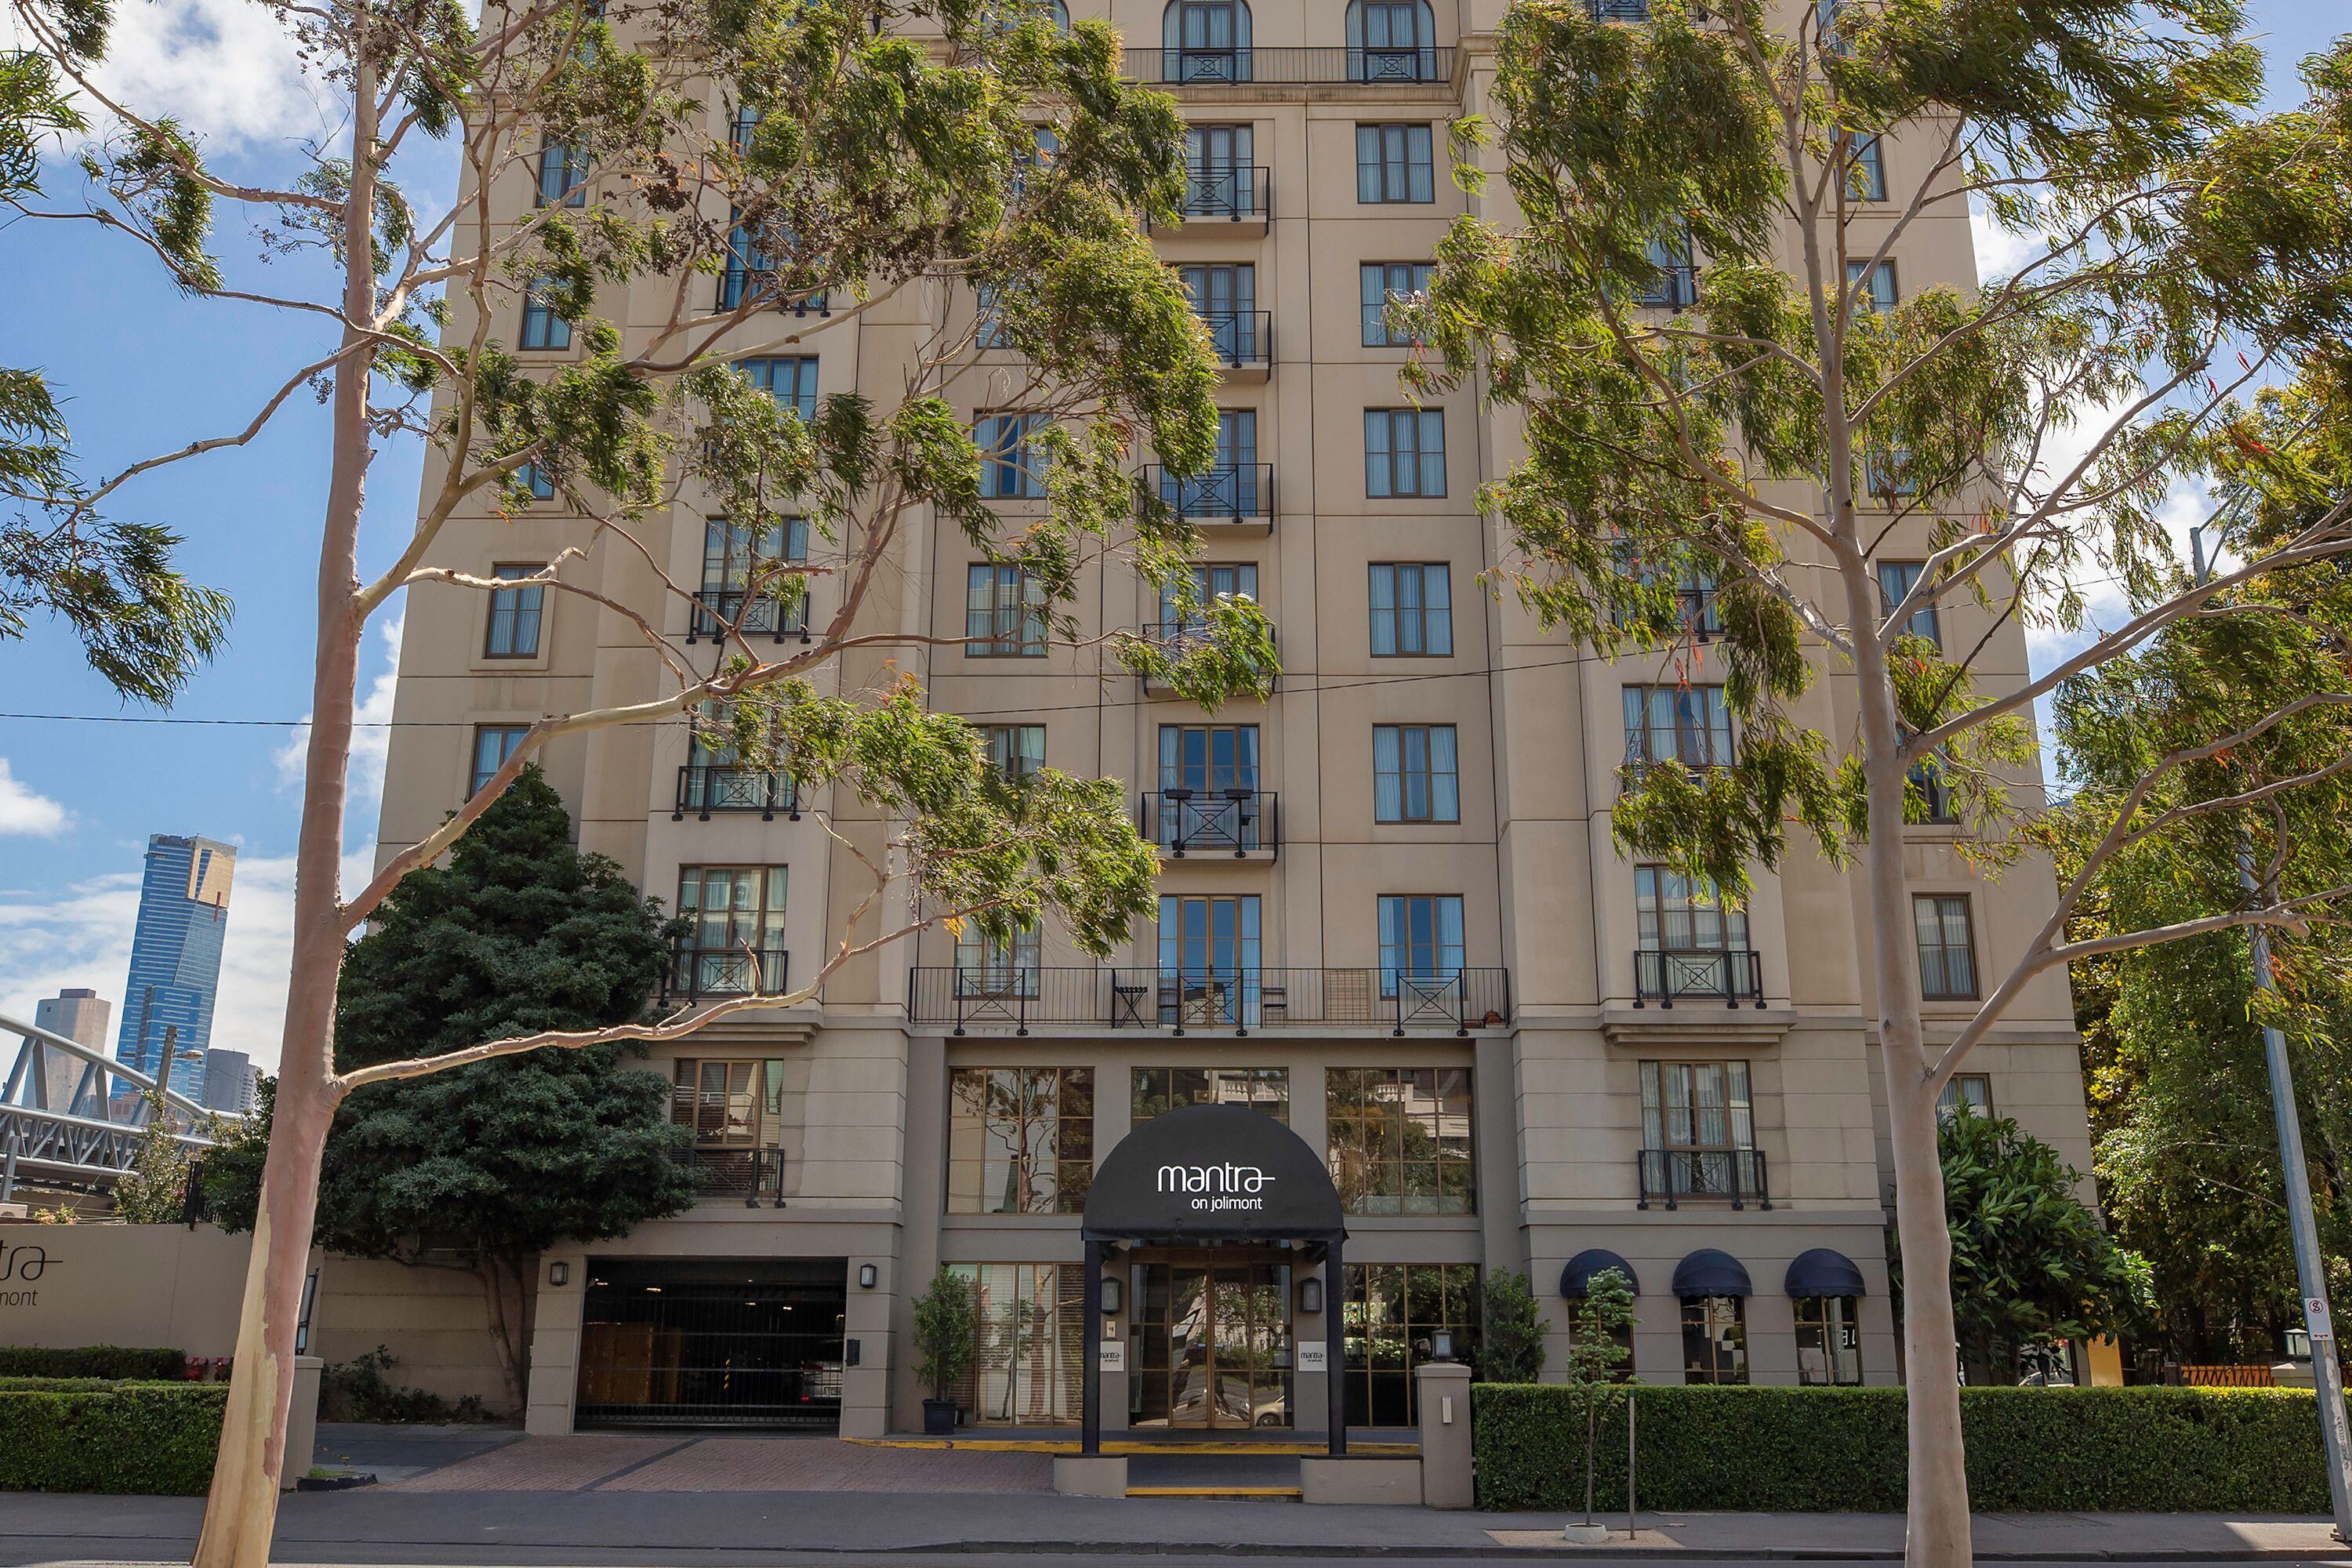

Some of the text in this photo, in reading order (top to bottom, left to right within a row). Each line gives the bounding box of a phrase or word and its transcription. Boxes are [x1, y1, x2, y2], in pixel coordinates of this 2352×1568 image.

[1158, 1162, 1276, 1192] mantra
[1192, 1196, 1263, 1212] on jolimont
